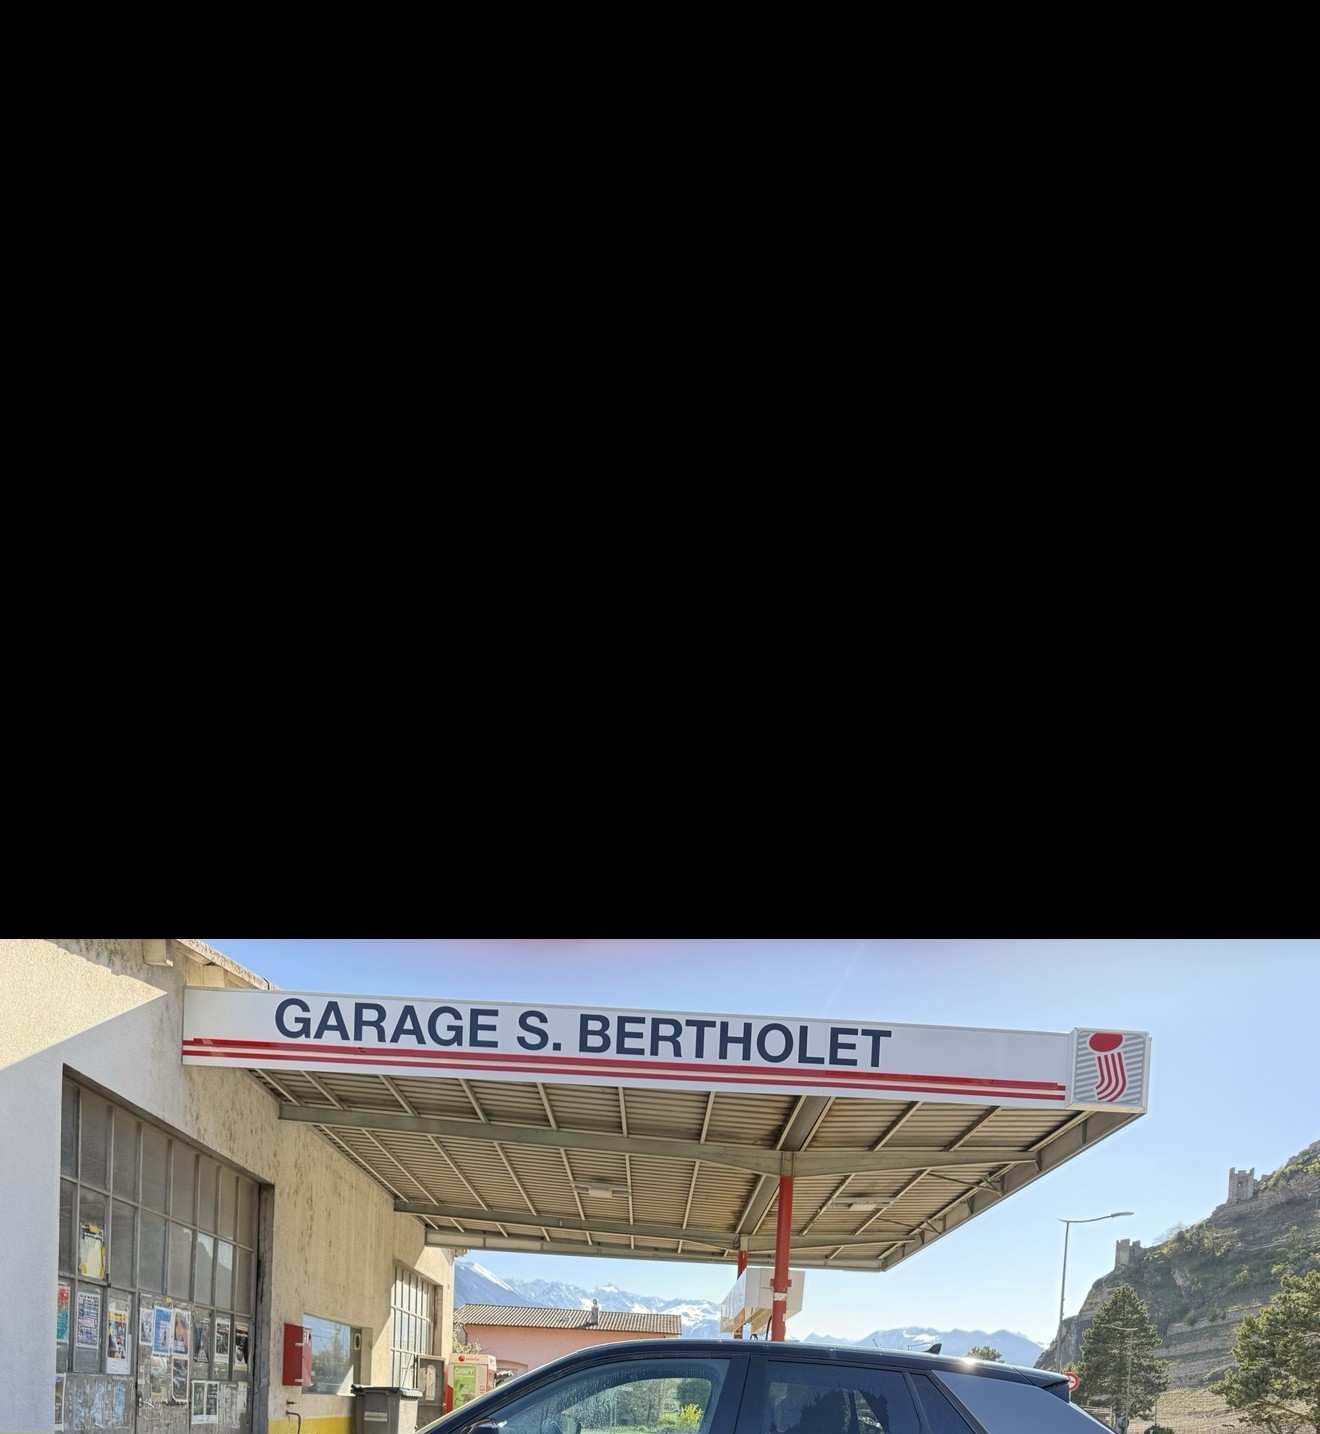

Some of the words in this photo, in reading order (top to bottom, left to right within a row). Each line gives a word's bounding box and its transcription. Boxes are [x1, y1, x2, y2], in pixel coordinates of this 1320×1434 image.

[275, 997, 499, 1048] GARAGE
[516, 1010, 562, 1052] S.
[578, 1013, 892, 1067] BERTHOLET
